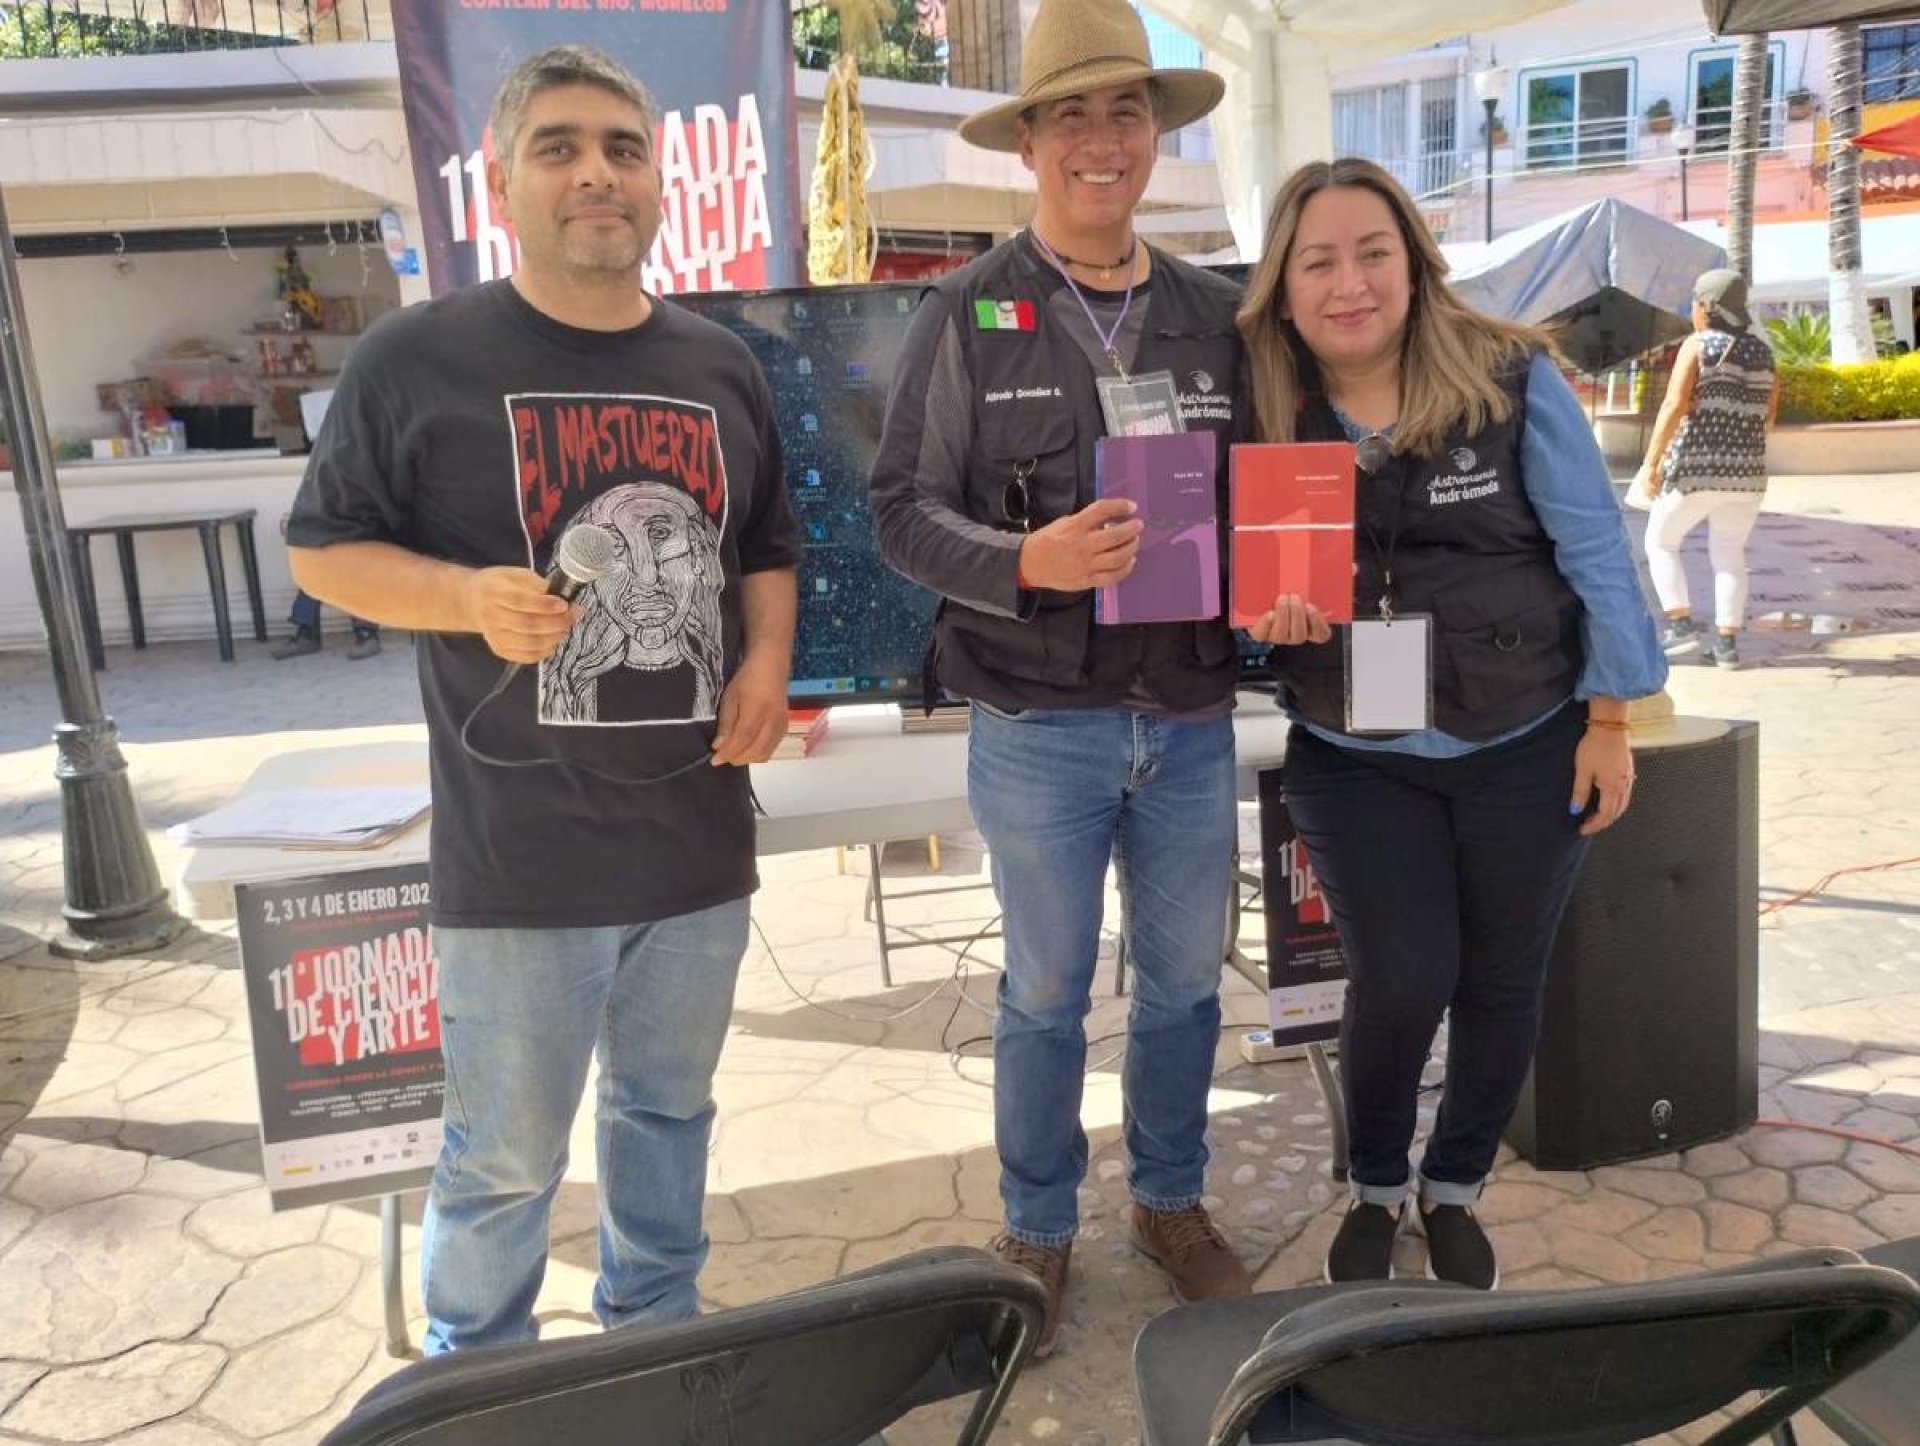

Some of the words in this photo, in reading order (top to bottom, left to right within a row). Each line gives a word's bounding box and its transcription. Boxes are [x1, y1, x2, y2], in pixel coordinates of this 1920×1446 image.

[554, 403, 724, 514] MASTUERZO
[263, 900, 281, 926] 2,
[282, 898, 294, 921] 3
[296, 896, 308, 919] Y
[311, 895, 322, 918] 4
[324, 892, 346, 916] DE
[348, 886, 397, 913] ENERO
[400, 882, 431, 906] 202
[287, 996, 326, 1043] DE
[328, 1021, 350, 1066] Y
[358, 999, 430, 1060] ARTE
